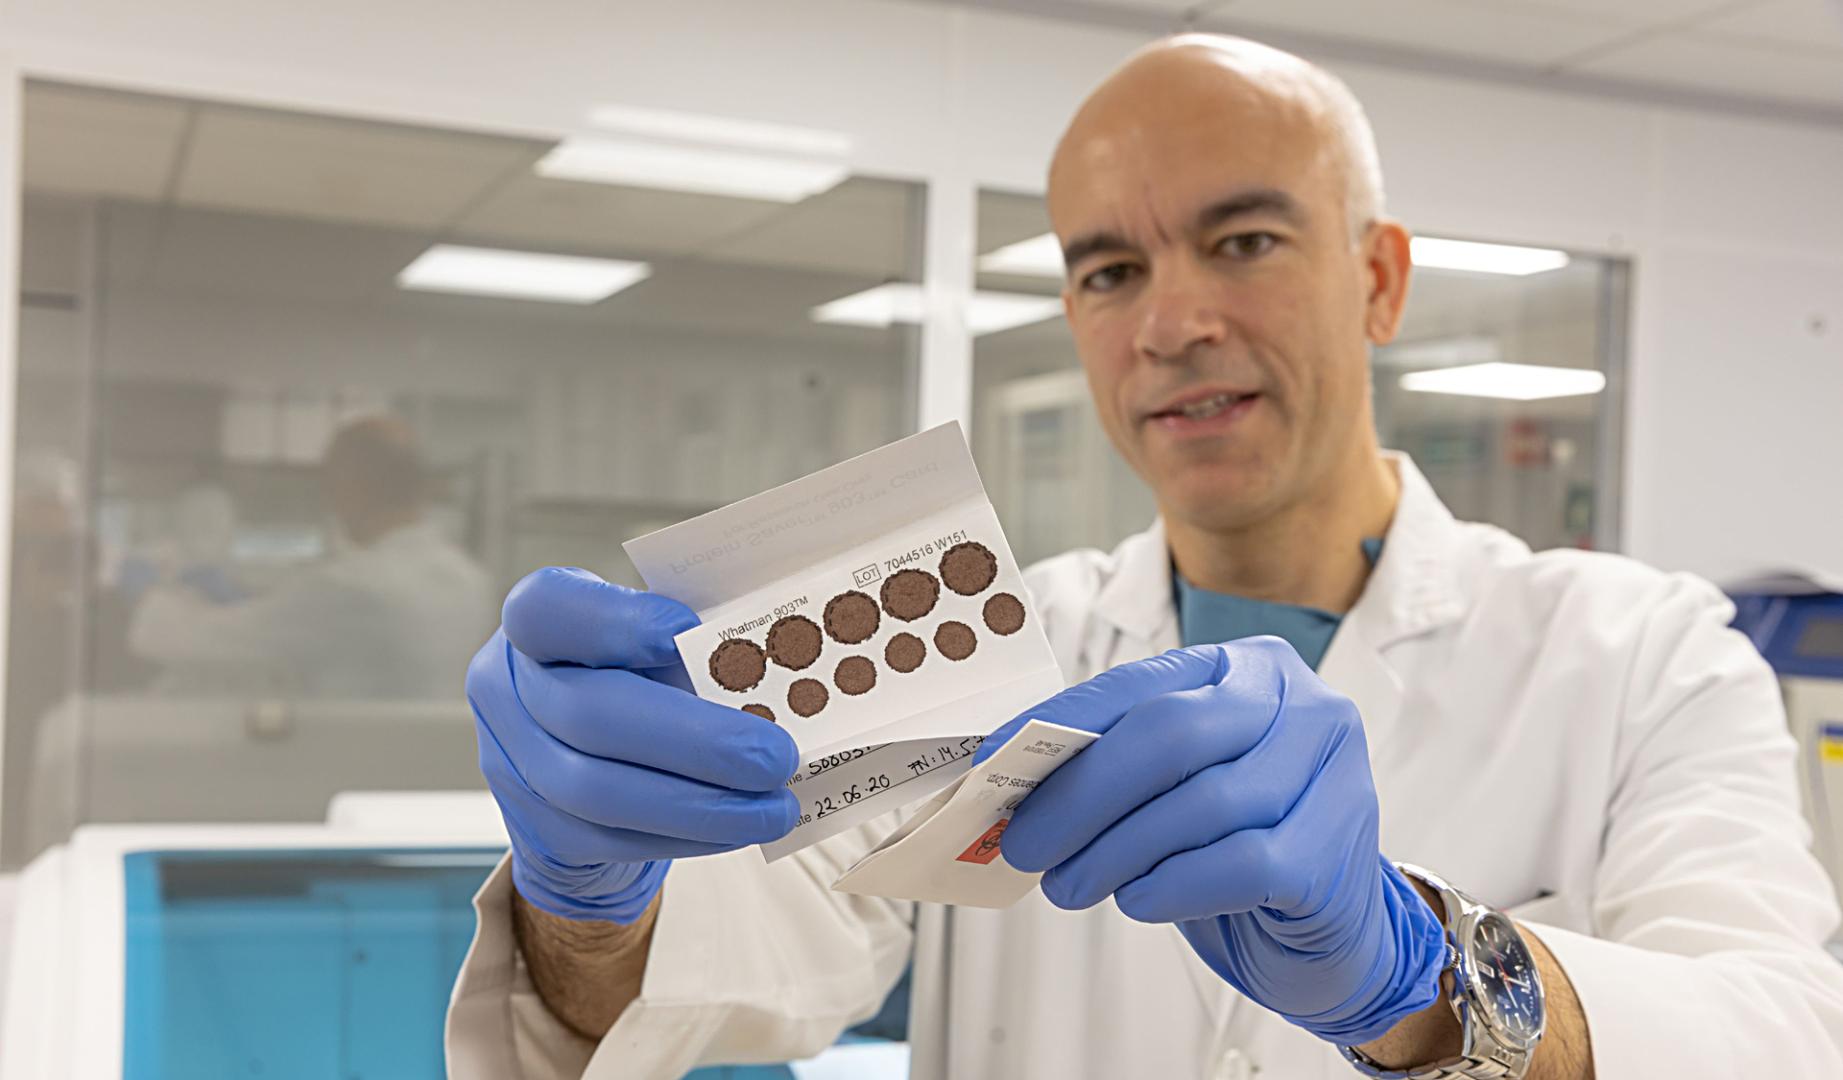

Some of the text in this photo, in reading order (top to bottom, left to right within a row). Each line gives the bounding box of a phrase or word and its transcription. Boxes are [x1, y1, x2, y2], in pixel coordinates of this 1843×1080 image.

[856, 529, 969, 586] LOT 7044516 W151
[717, 612, 773, 642] Whatman
[815, 774, 890, 818] 22.06.20
